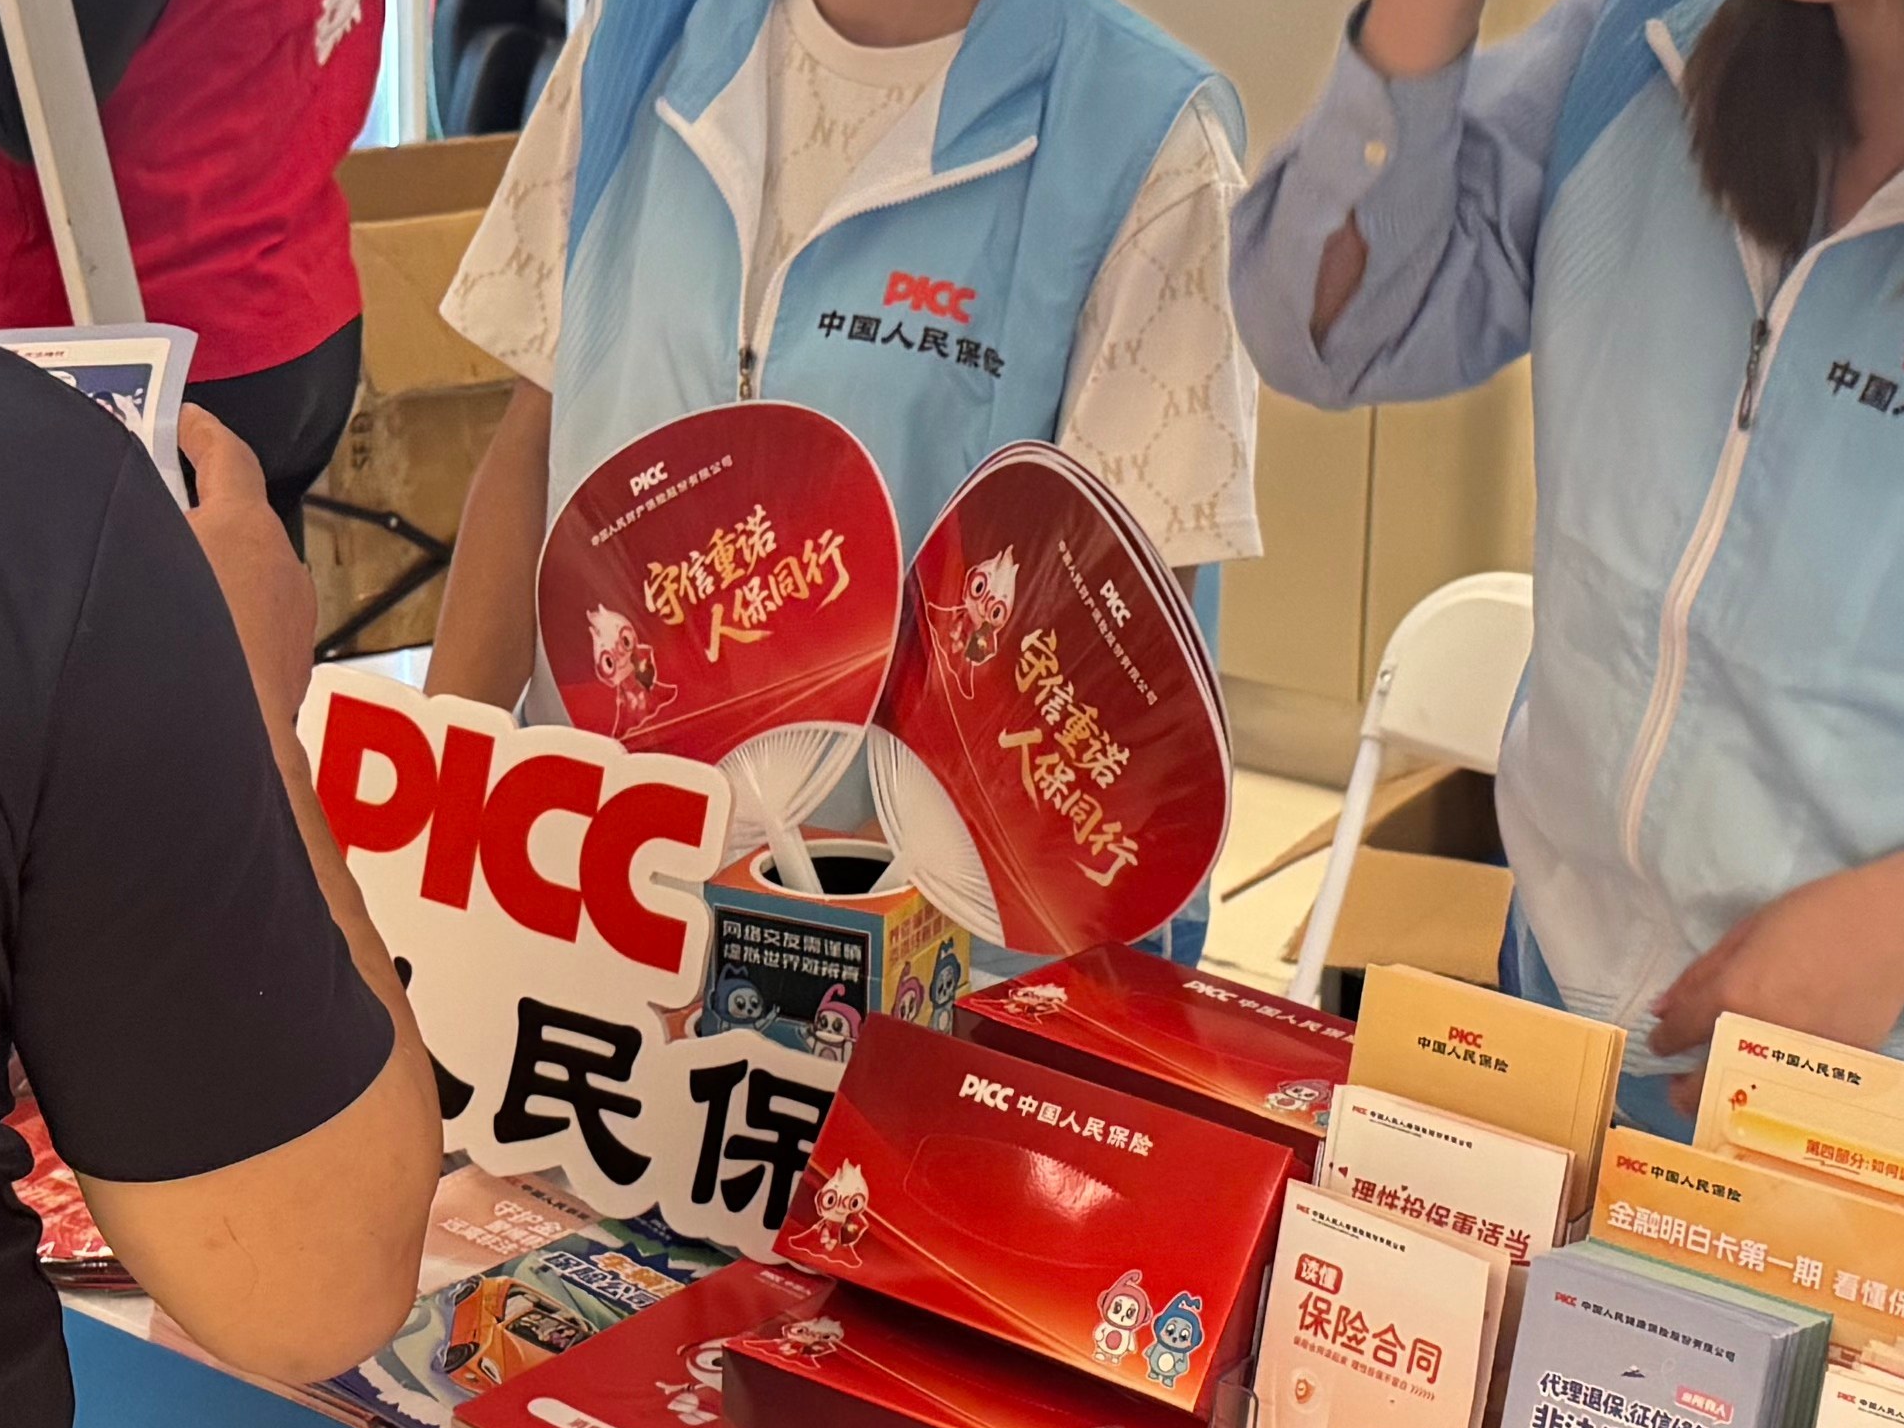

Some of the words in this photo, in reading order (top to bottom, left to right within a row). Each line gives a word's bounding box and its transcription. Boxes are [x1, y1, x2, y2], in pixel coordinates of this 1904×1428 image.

[882, 269, 978, 325] PICC
[817, 309, 1005, 378] 中国人民保险
[629, 460, 669, 498] PICC
[643, 503, 777, 626] 守信重诺
[704, 528, 852, 664] 人保同行
[1099, 578, 1132, 629] PICC
[1014, 627, 1131, 791] 守信重诺
[316, 690, 710, 975] PICC
[998, 726, 1140, 888] 人保同行
[1182, 979, 1239, 1003] PICC
[1417, 1036, 1509, 1074] 中国人民保险
[1448, 1025, 1484, 1049] PICC
[1738, 1039, 1770, 1060] PICC
[1771, 1049, 1862, 1086] 中国人民保险
[393, 956, 838, 1231] 民保
[958, 1073, 1015, 1113] PICC
[1017, 1094, 1154, 1157] 中国人民保险
[1616, 1154, 1648, 1176] PICC
[1650, 1165, 1742, 1204] 中国人民保险
[1300, 1257, 1339, 1291] 读懂
[1607, 1199, 1824, 1290] 金融明白卡第一期
[1298, 1291, 1443, 1385] 保险合同
